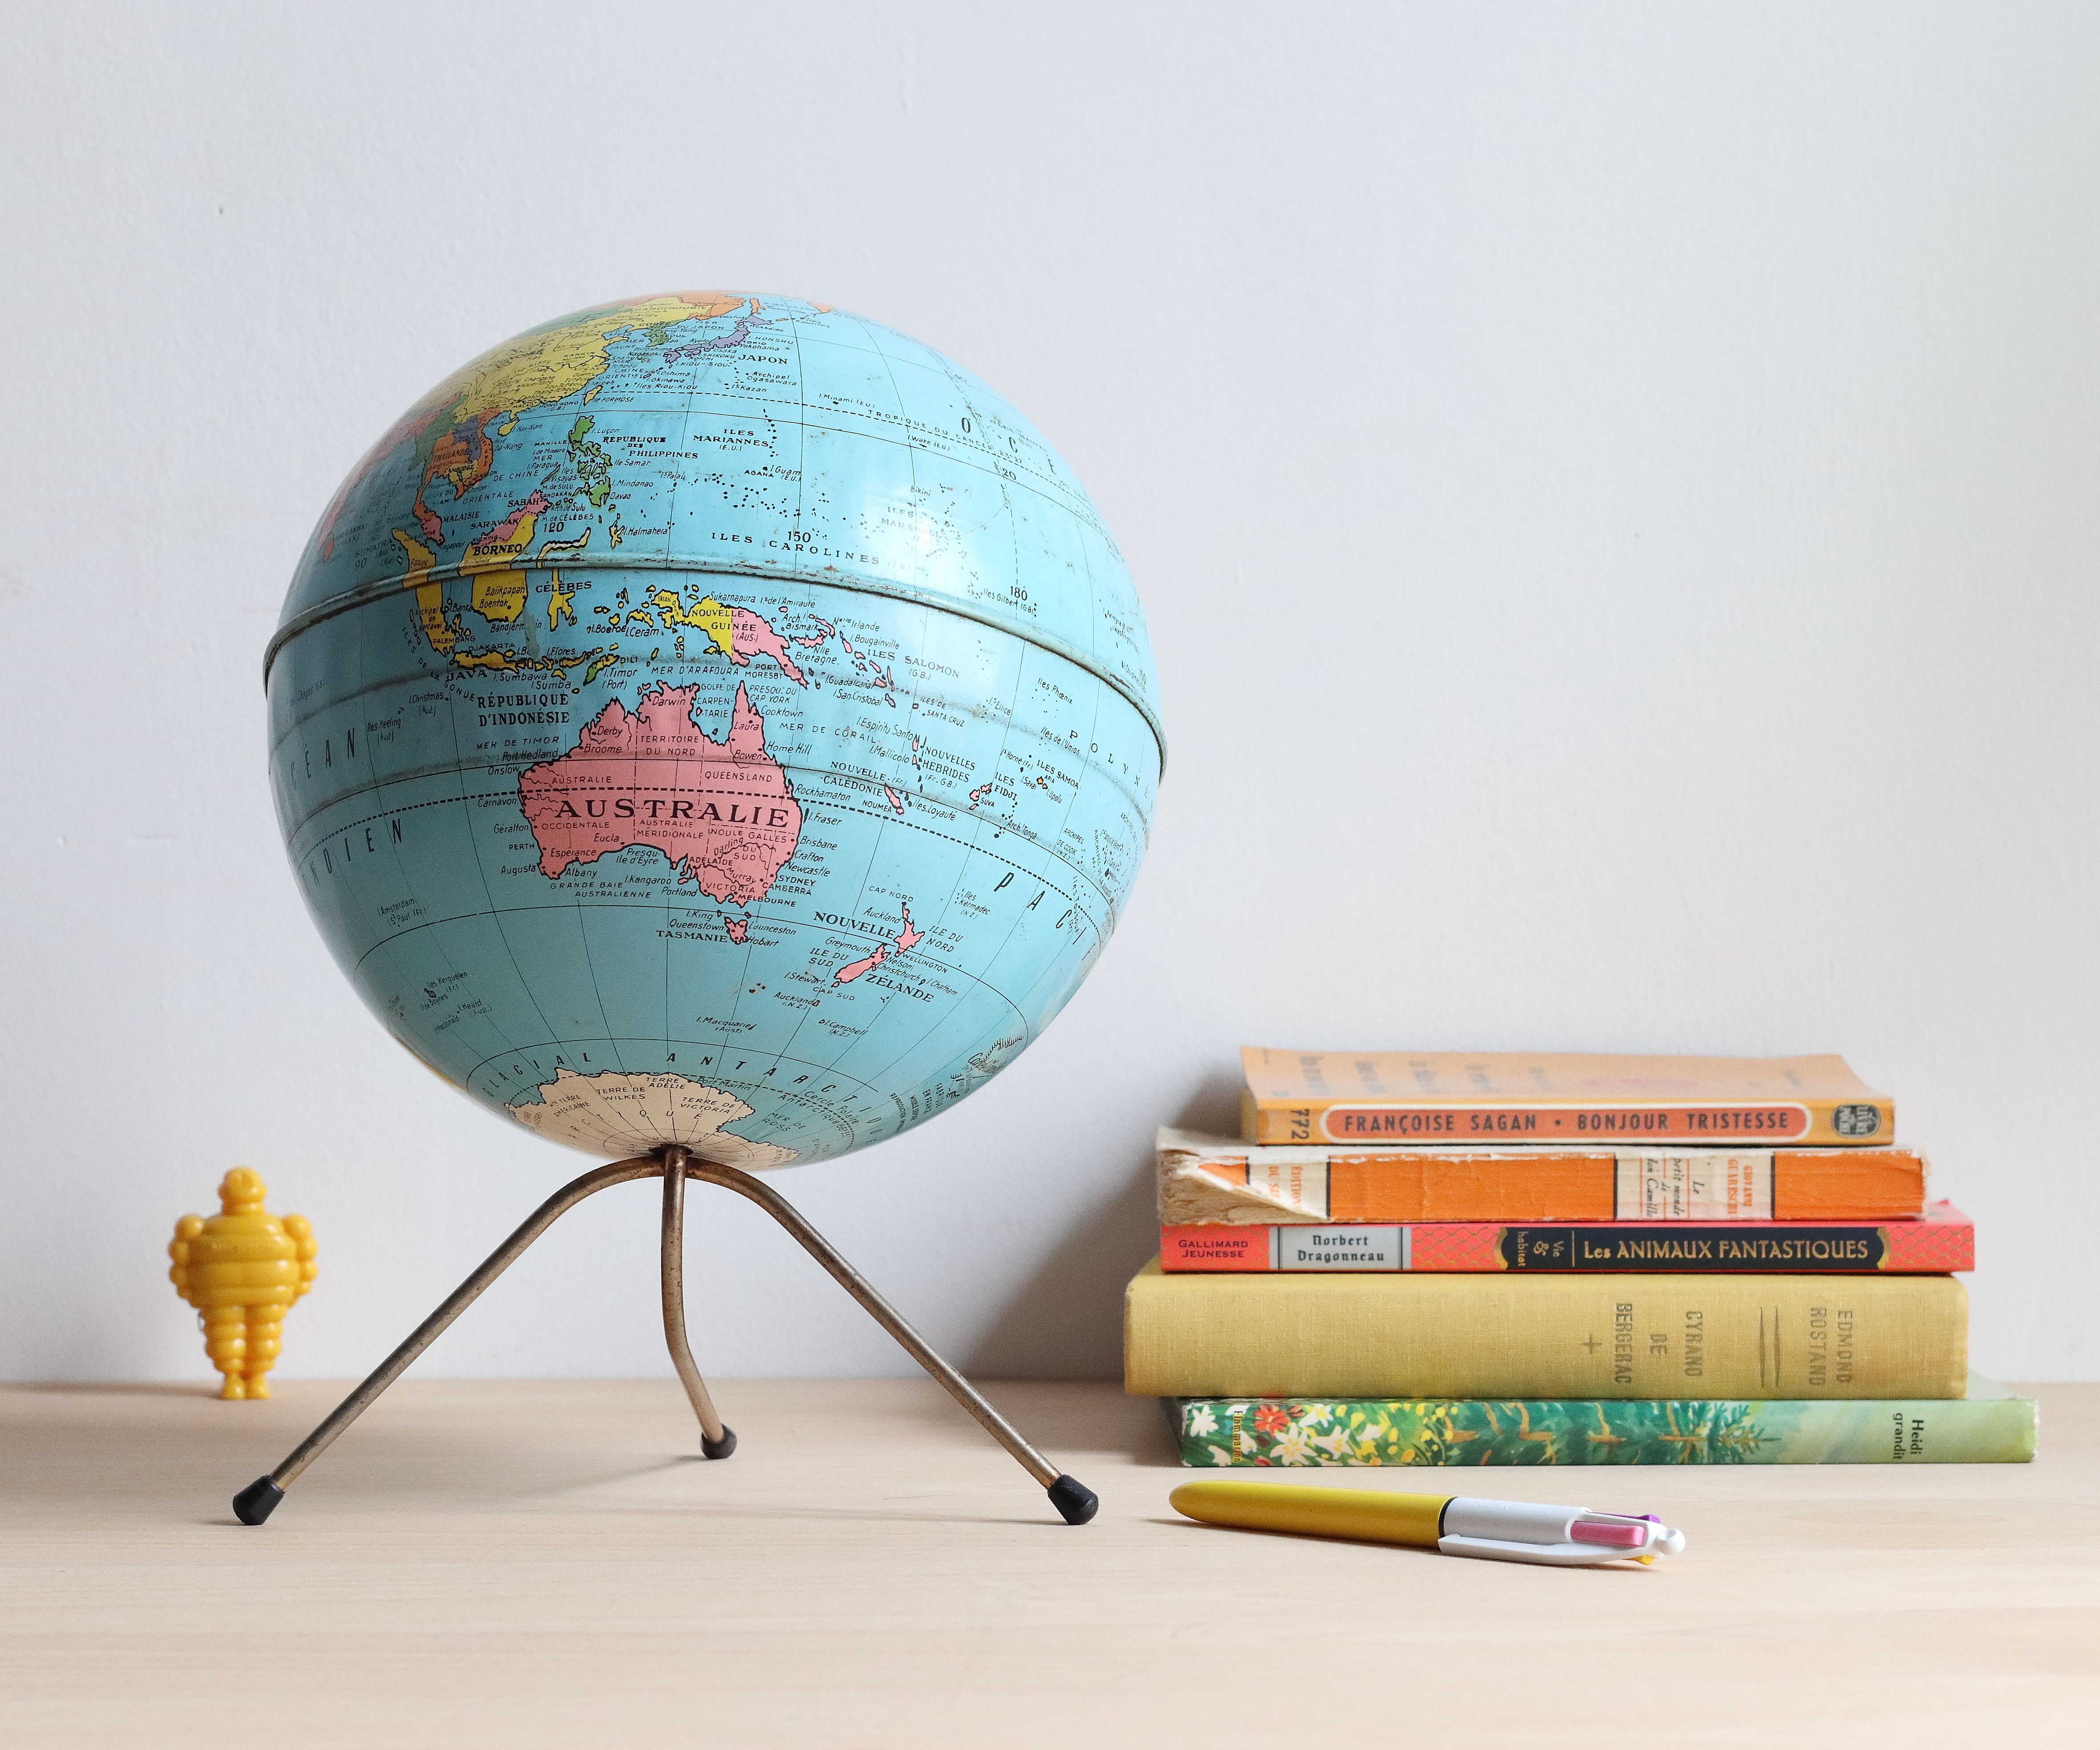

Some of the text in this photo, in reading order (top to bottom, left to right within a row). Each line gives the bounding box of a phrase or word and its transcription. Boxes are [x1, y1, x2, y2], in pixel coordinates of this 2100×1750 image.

[738, 354, 788, 365] JAPON
[747, 376, 797, 386] Ogasawara
[693, 435, 769, 447] MARIANNES
[629, 450, 698, 459] PHILIPPINES
[1002, 468, 1016, 480] 20
[463, 490, 514, 505] ORIENTALE
[910, 486, 931, 497] Bikini
[443, 511, 480, 523] MALAISIE
[887, 506, 914, 518] ILES
[470, 518, 520, 530] SARAWAK
[544, 522, 564, 533] 120
[788, 531, 811, 543] 150
[473, 543, 522, 556] BORNEO
[712, 532, 879, 564] ILES CAROLINES
[535, 581, 592, 593] CÉLÈBES
[1010, 586, 1028, 601] 180
[479, 599, 509, 609] Boentok
[709, 591, 756, 604] Sukarnapura
[692, 609, 745, 617] NOUVELLE
[711, 620, 756, 632] GUINÉE
[433, 635, 476, 645] PALEMBANG
[469, 642, 516, 652] DJAKARTA
[620, 656, 638, 664] DILI
[868, 649, 960, 678] ILES SALOMON
[446, 670, 487, 682] JAVA
[477, 692, 569, 709] RÉPUBLIQUE
[652, 696, 686, 706] Darwin
[769, 695, 790, 703] YORK
[479, 708, 570, 727] D'INDONÉSIE
[761, 705, 803, 717] Cooktown
[926, 709, 964, 727] SANTA CRUZ
[597, 725, 623, 737] Derby
[734, 722, 759, 731] Laura
[641, 735, 699, 743] TERRITOIRE
[780, 723, 876, 744] MER DE CORAIL
[477, 741, 497, 750] MER
[523, 736, 559, 745] TIMOR
[584, 744, 622, 753] Broome
[765, 741, 813, 754] Home Hill
[668, 748, 695, 756] NORD
[734, 749, 762, 760] Bowen
[926, 746, 976, 771] NOUVELLES
[488, 765, 520, 775] Onslow
[705, 771, 772, 782] QUEENSLAND
[1036, 759, 1079, 789] ILES SAMOA
[552, 776, 611, 784] AUSTRALIE
[995, 772, 1015, 786] ILES
[994, 786, 1017, 801] FIDJI
[477, 798, 517, 808] Carnavon
[980, 797, 995, 808] SUVA
[554, 799, 789, 828] AUSTRALIE
[542, 822, 610, 830] OCCIDENTALE
[640, 819, 693, 828] AUSTRALIE
[594, 833, 619, 843] Eucla
[637, 826, 704, 839] MÉRIDIONALE
[1064, 828, 1085, 844] ARCHIPEL
[800, 836, 838, 850] Brisbane
[501, 864, 536, 876] Augusta
[565, 867, 598, 878] Albany
[727, 867, 757, 884] Murray
[785, 862, 831, 877] Newcastle
[550, 882, 595, 890] GRANDE
[778, 875, 816, 887] SYDNEY
[661, 886, 697, 897] Portland
[706, 883, 756, 893] VICTORIA
[869, 885, 914, 903] CAP NORD
[738, 894, 797, 907] MELBOURNE
[964, 891, 976, 901] Iles
[959, 899, 991, 915] Kermadec
[863, 906, 901, 924] Auckland
[749, 921, 797, 935] Launceston
[813, 911, 896, 940] NOUVELLE
[656, 930, 728, 943] TASMANIE
[747, 936, 779, 947] Hobart
[825, 936, 870, 954] Greymouth
[926, 938, 955, 953] NORD
[886, 956, 912, 971] Nelson
[902, 953, 948, 974] WELLINGTON
[876, 963, 920, 982] Christchurch
[865, 973, 934, 1003] ZÉLANDE
[824, 1020, 869, 1036] I.Campbell
[648, 1081, 686, 1090] ADÉLIE
[603, 1093, 646, 1101] WILKES
[682, 1096, 736, 1109] TERRE DE
[680, 1103, 731, 1114] VICTORIA
[777, 1094, 839, 1124] Antarctique
[763, 1118, 791, 1133] ROSS
[1291, 1109, 1309, 1140] 772
[1344, 1112, 1789, 1135] FRANÇOISE SAGAN BONJOUR TRISTESSE
[1692, 1181, 1705, 1195] Le
[1178, 1239, 1249, 1248] GALLIMARD
[1313, 1235, 1369, 1246] Norbert
[1182, 1249, 1244, 1258] JEUNESSE
[1517, 1231, 1526, 1268] habitat
[1584, 1239, 1869, 1262] Les ANIMAUX FANTASTIQUES
[1298, 1249, 1385, 1264] Dragonneau
[1615, 1302, 1633, 1384] BERGERAC
[1650, 1333, 1667, 1355] DE
[1684, 1309, 1703, 1377] CYRANO
[1809, 1307, 1827, 1387] ROSTAND
[1837, 1309, 1853, 1384] EDMOND
[1233, 1410, 1242, 1464] Flammarion
[1893, 1412, 1904, 1459] grandit
[1912, 1418, 1924, 1455] Heidi
